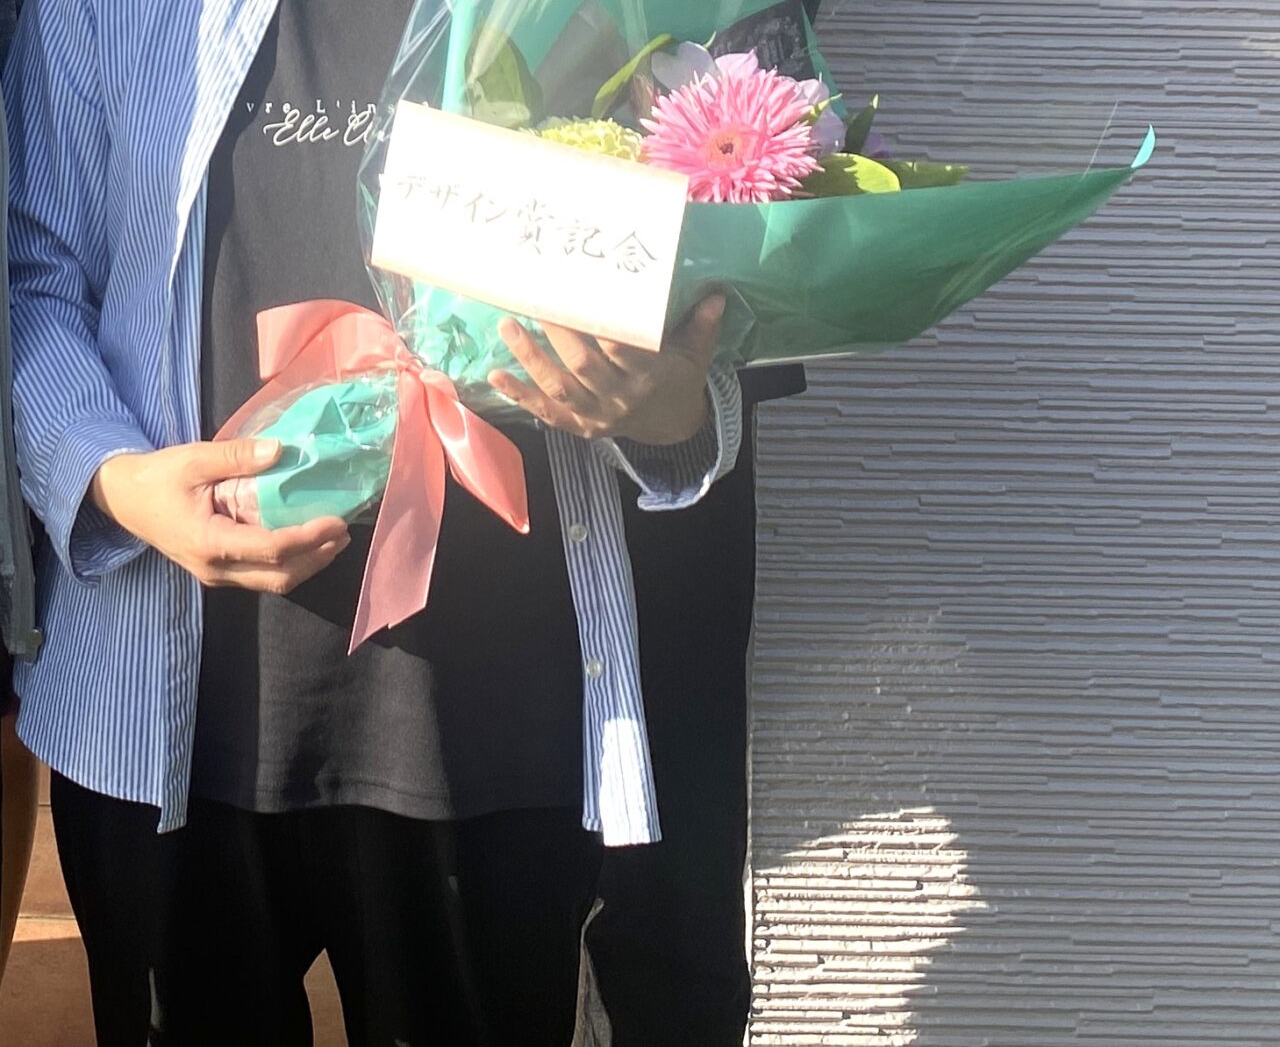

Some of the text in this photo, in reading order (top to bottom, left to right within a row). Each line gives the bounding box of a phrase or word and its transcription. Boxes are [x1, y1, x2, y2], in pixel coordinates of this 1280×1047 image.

[245, 101, 292, 114] vre
[263, 109, 340, 147] Elle
[398, 175, 658, 273] デザイン賞記念
